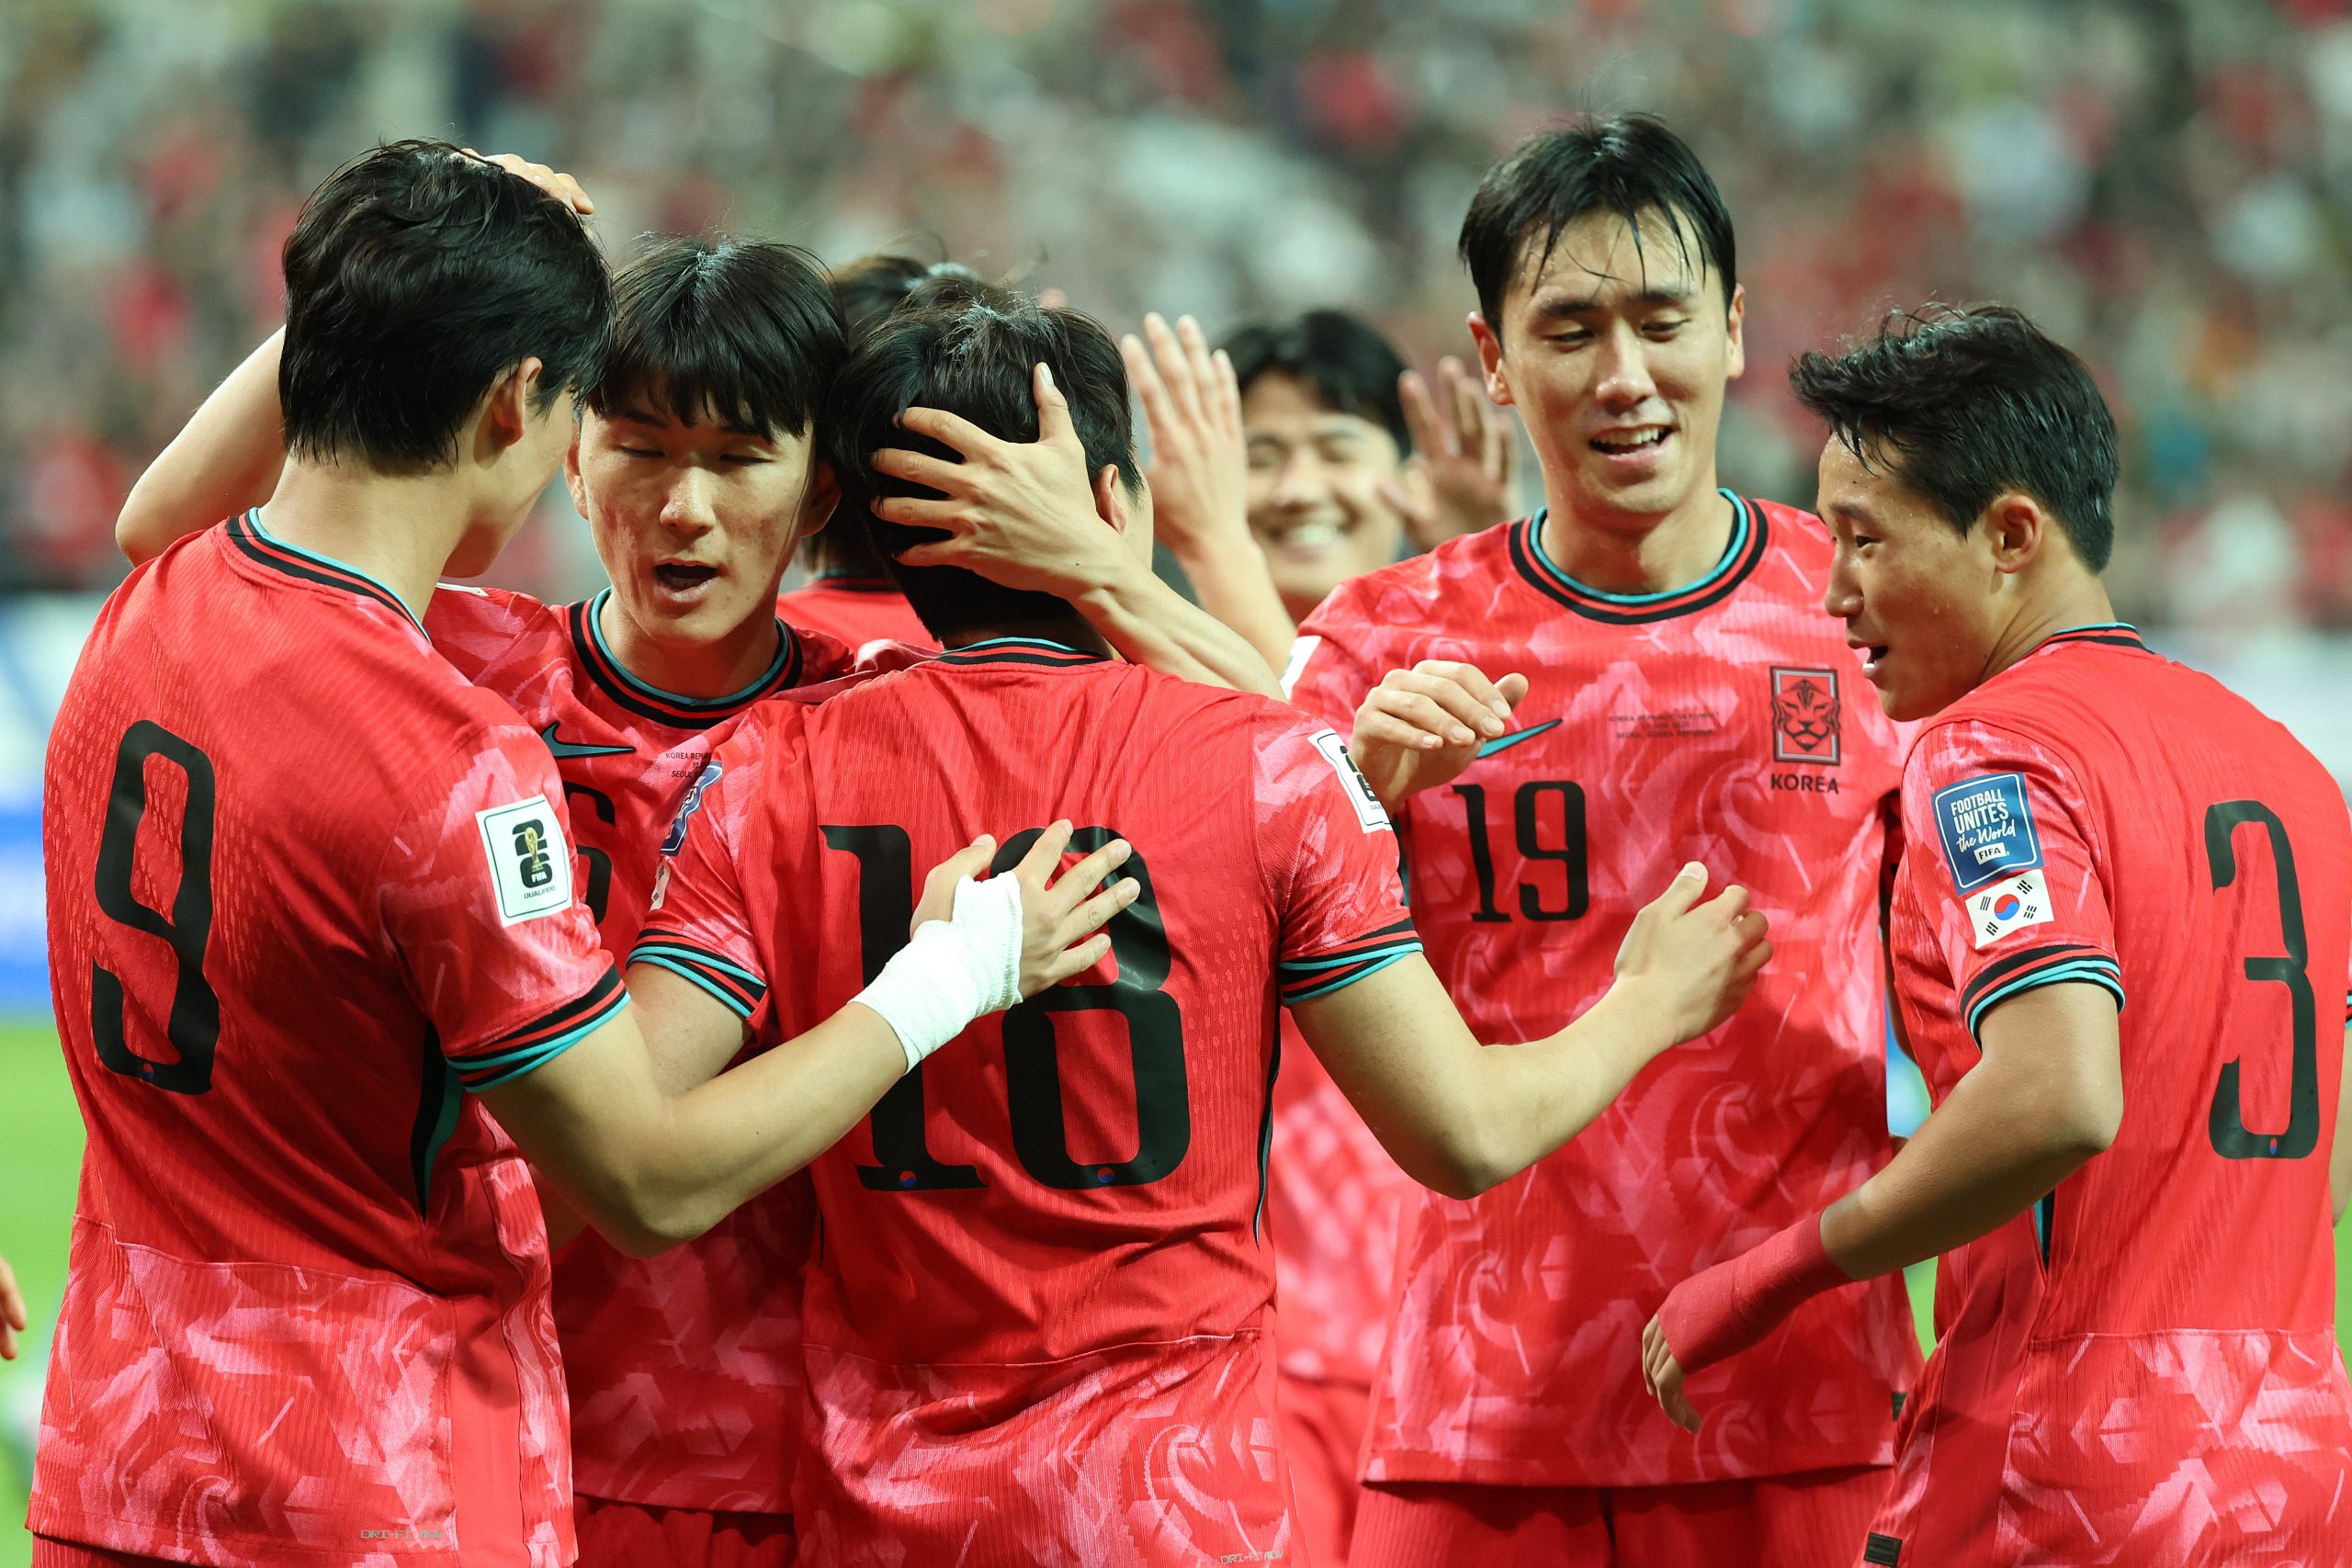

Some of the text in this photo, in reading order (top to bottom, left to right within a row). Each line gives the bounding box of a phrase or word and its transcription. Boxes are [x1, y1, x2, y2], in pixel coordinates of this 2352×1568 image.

[665, 751, 689, 760] KOREA
[1770, 773, 1839, 795] KOREA
[1950, 788, 2006, 817] FOOTBALL
[1953, 802, 2009, 834] UNITES
[1956, 818, 2017, 852] the World
[1452, 781, 1589, 923] 19
[1978, 847, 2001, 860] FIFA
[92, 719, 220, 1096] 9
[2204, 799, 2320, 1159] 3
[819, 824, 1192, 1191] 18
